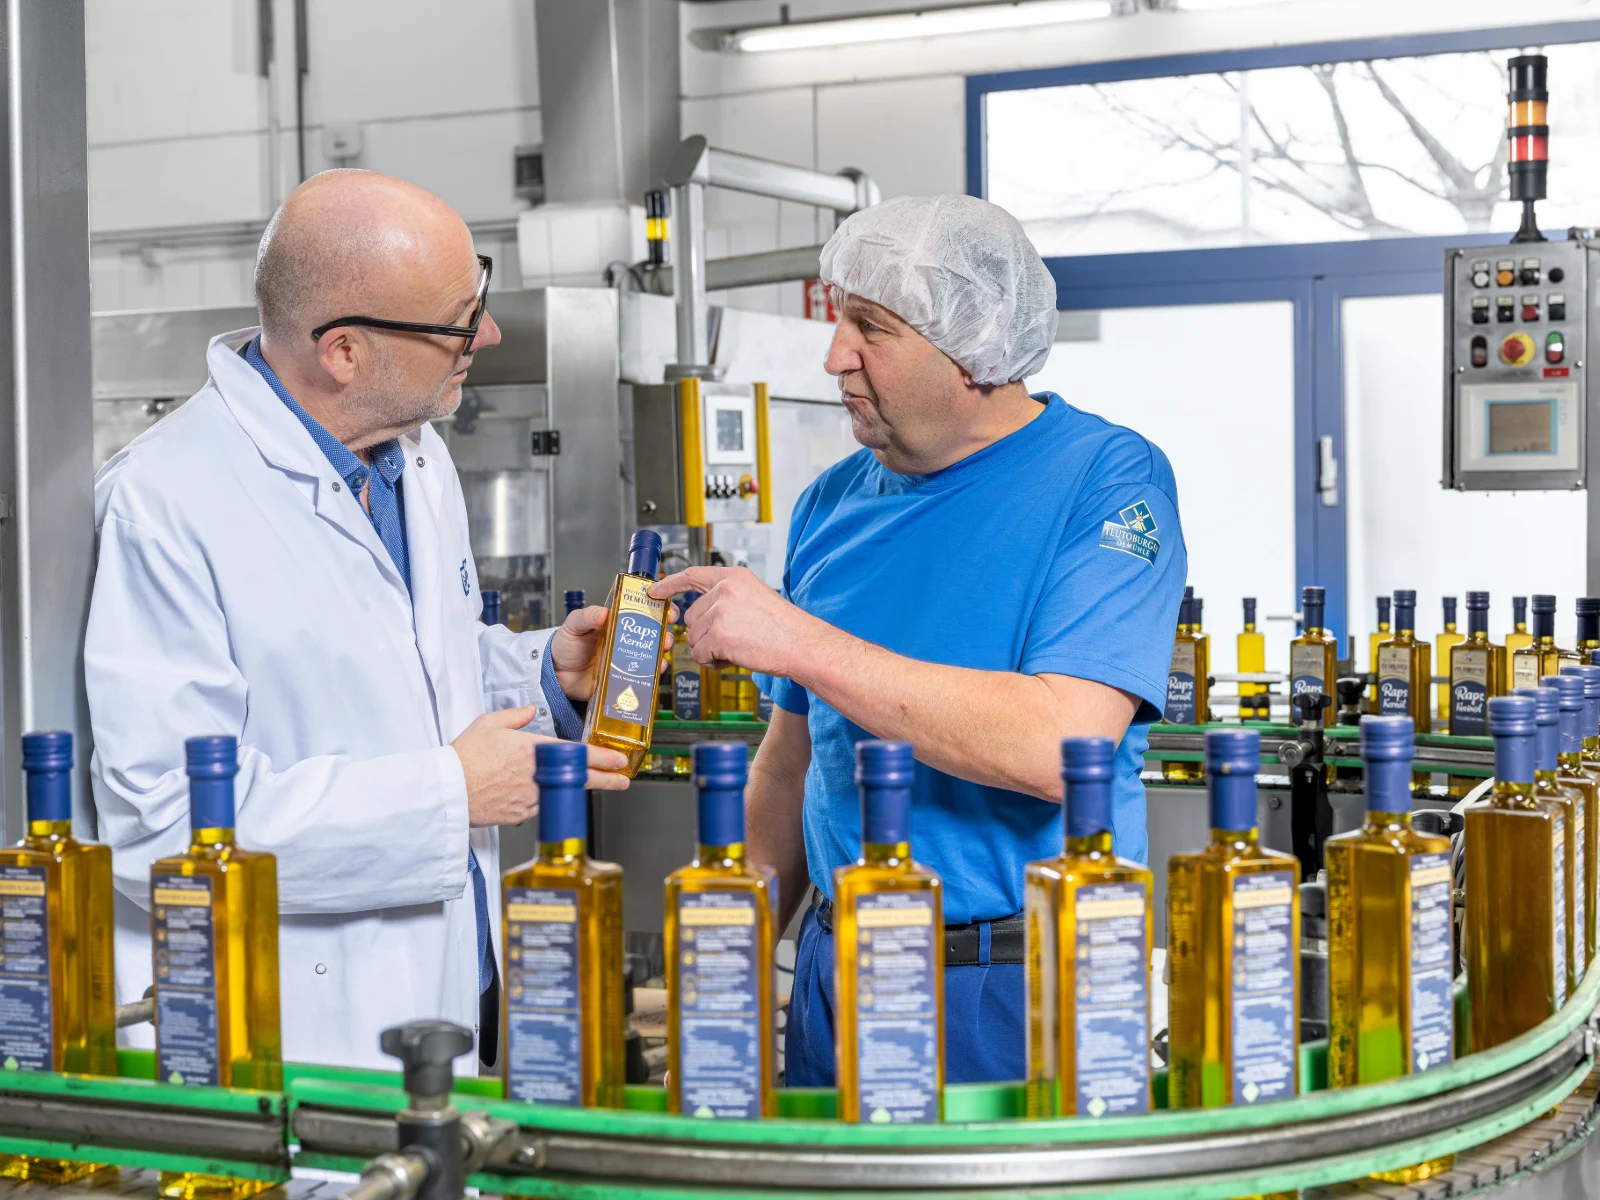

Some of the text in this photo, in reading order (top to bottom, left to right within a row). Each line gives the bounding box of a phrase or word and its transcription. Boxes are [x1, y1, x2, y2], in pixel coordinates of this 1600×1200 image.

[621, 616, 658, 640] Raps
[620, 633, 654, 650] Kernöl
[617, 647, 653, 660] nussig-fein
[675, 675, 699, 692] Raps
[1168, 676, 1193, 694] Raps
[1381, 683, 1408, 702] Raps
[1455, 685, 1485, 705] Raps
